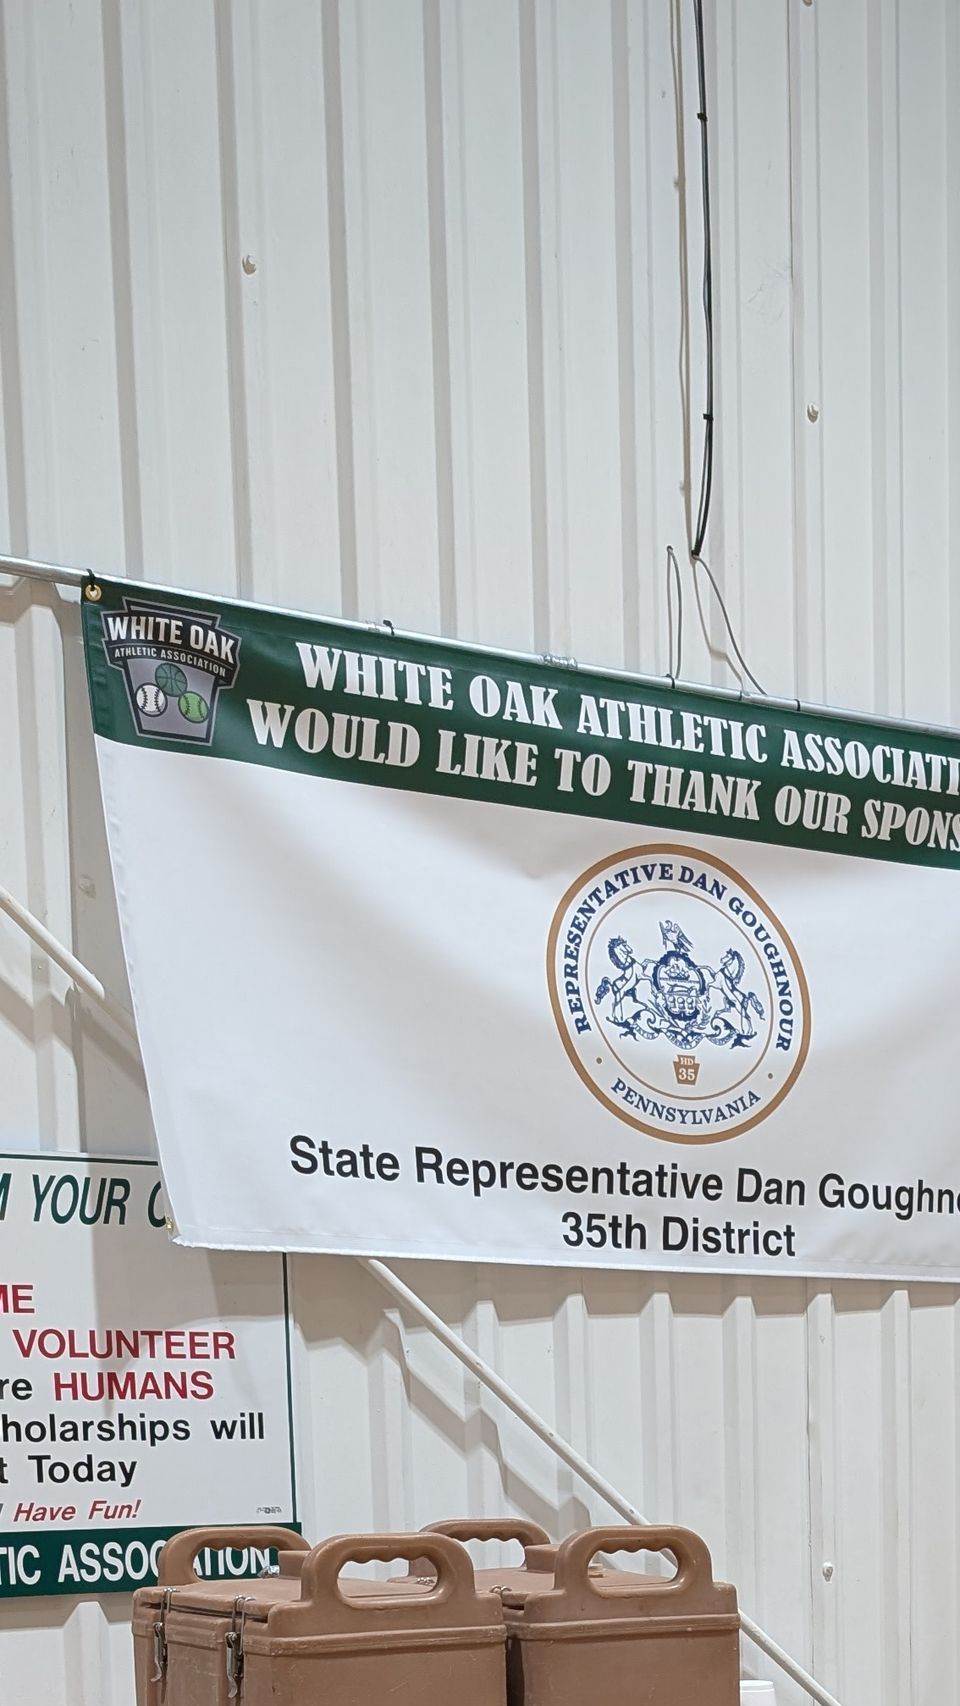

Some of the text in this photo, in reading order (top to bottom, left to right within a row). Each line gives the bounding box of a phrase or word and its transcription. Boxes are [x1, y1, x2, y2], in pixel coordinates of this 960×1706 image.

[107, 616, 235, 664] WHITE OAK
[115, 647, 226, 677] ATHLETIC ASSOCIATION
[297, 642, 454, 711] WHITE
[469, 675, 563, 730] OAK
[577, 694, 767, 763] ATHLETIC
[246, 698, 421, 767] WOULD
[436, 730, 538, 786] LIKE
[554, 747, 612, 796] TO
[627, 760, 760, 821] THANK
[774, 785, 850, 836] OUR
[563, 863, 794, 1051] REPRESENTATIVE DAN GOUGHNOUR
[678, 1068, 695, 1081] 35
[679, 1057, 695, 1066] HD
[610, 1077, 761, 1125] PENNSYLVANIA
[289, 1135, 400, 1182] State
[414, 1147, 723, 1203] Representative
[736, 1168, 806, 1206] Dan
[32, 1174, 130, 1225] YOUR
[562, 1211, 797, 1258] 35th District
[12, 1329, 236, 1360] VOLUNTEER
[54, 1371, 214, 1401] HUMANS
[1, 1412, 265, 1447] holarships will
[28, 1454, 137, 1487] Today
[13, 1501, 76, 1522] Have
[88, 1499, 141, 1520] Fun!
